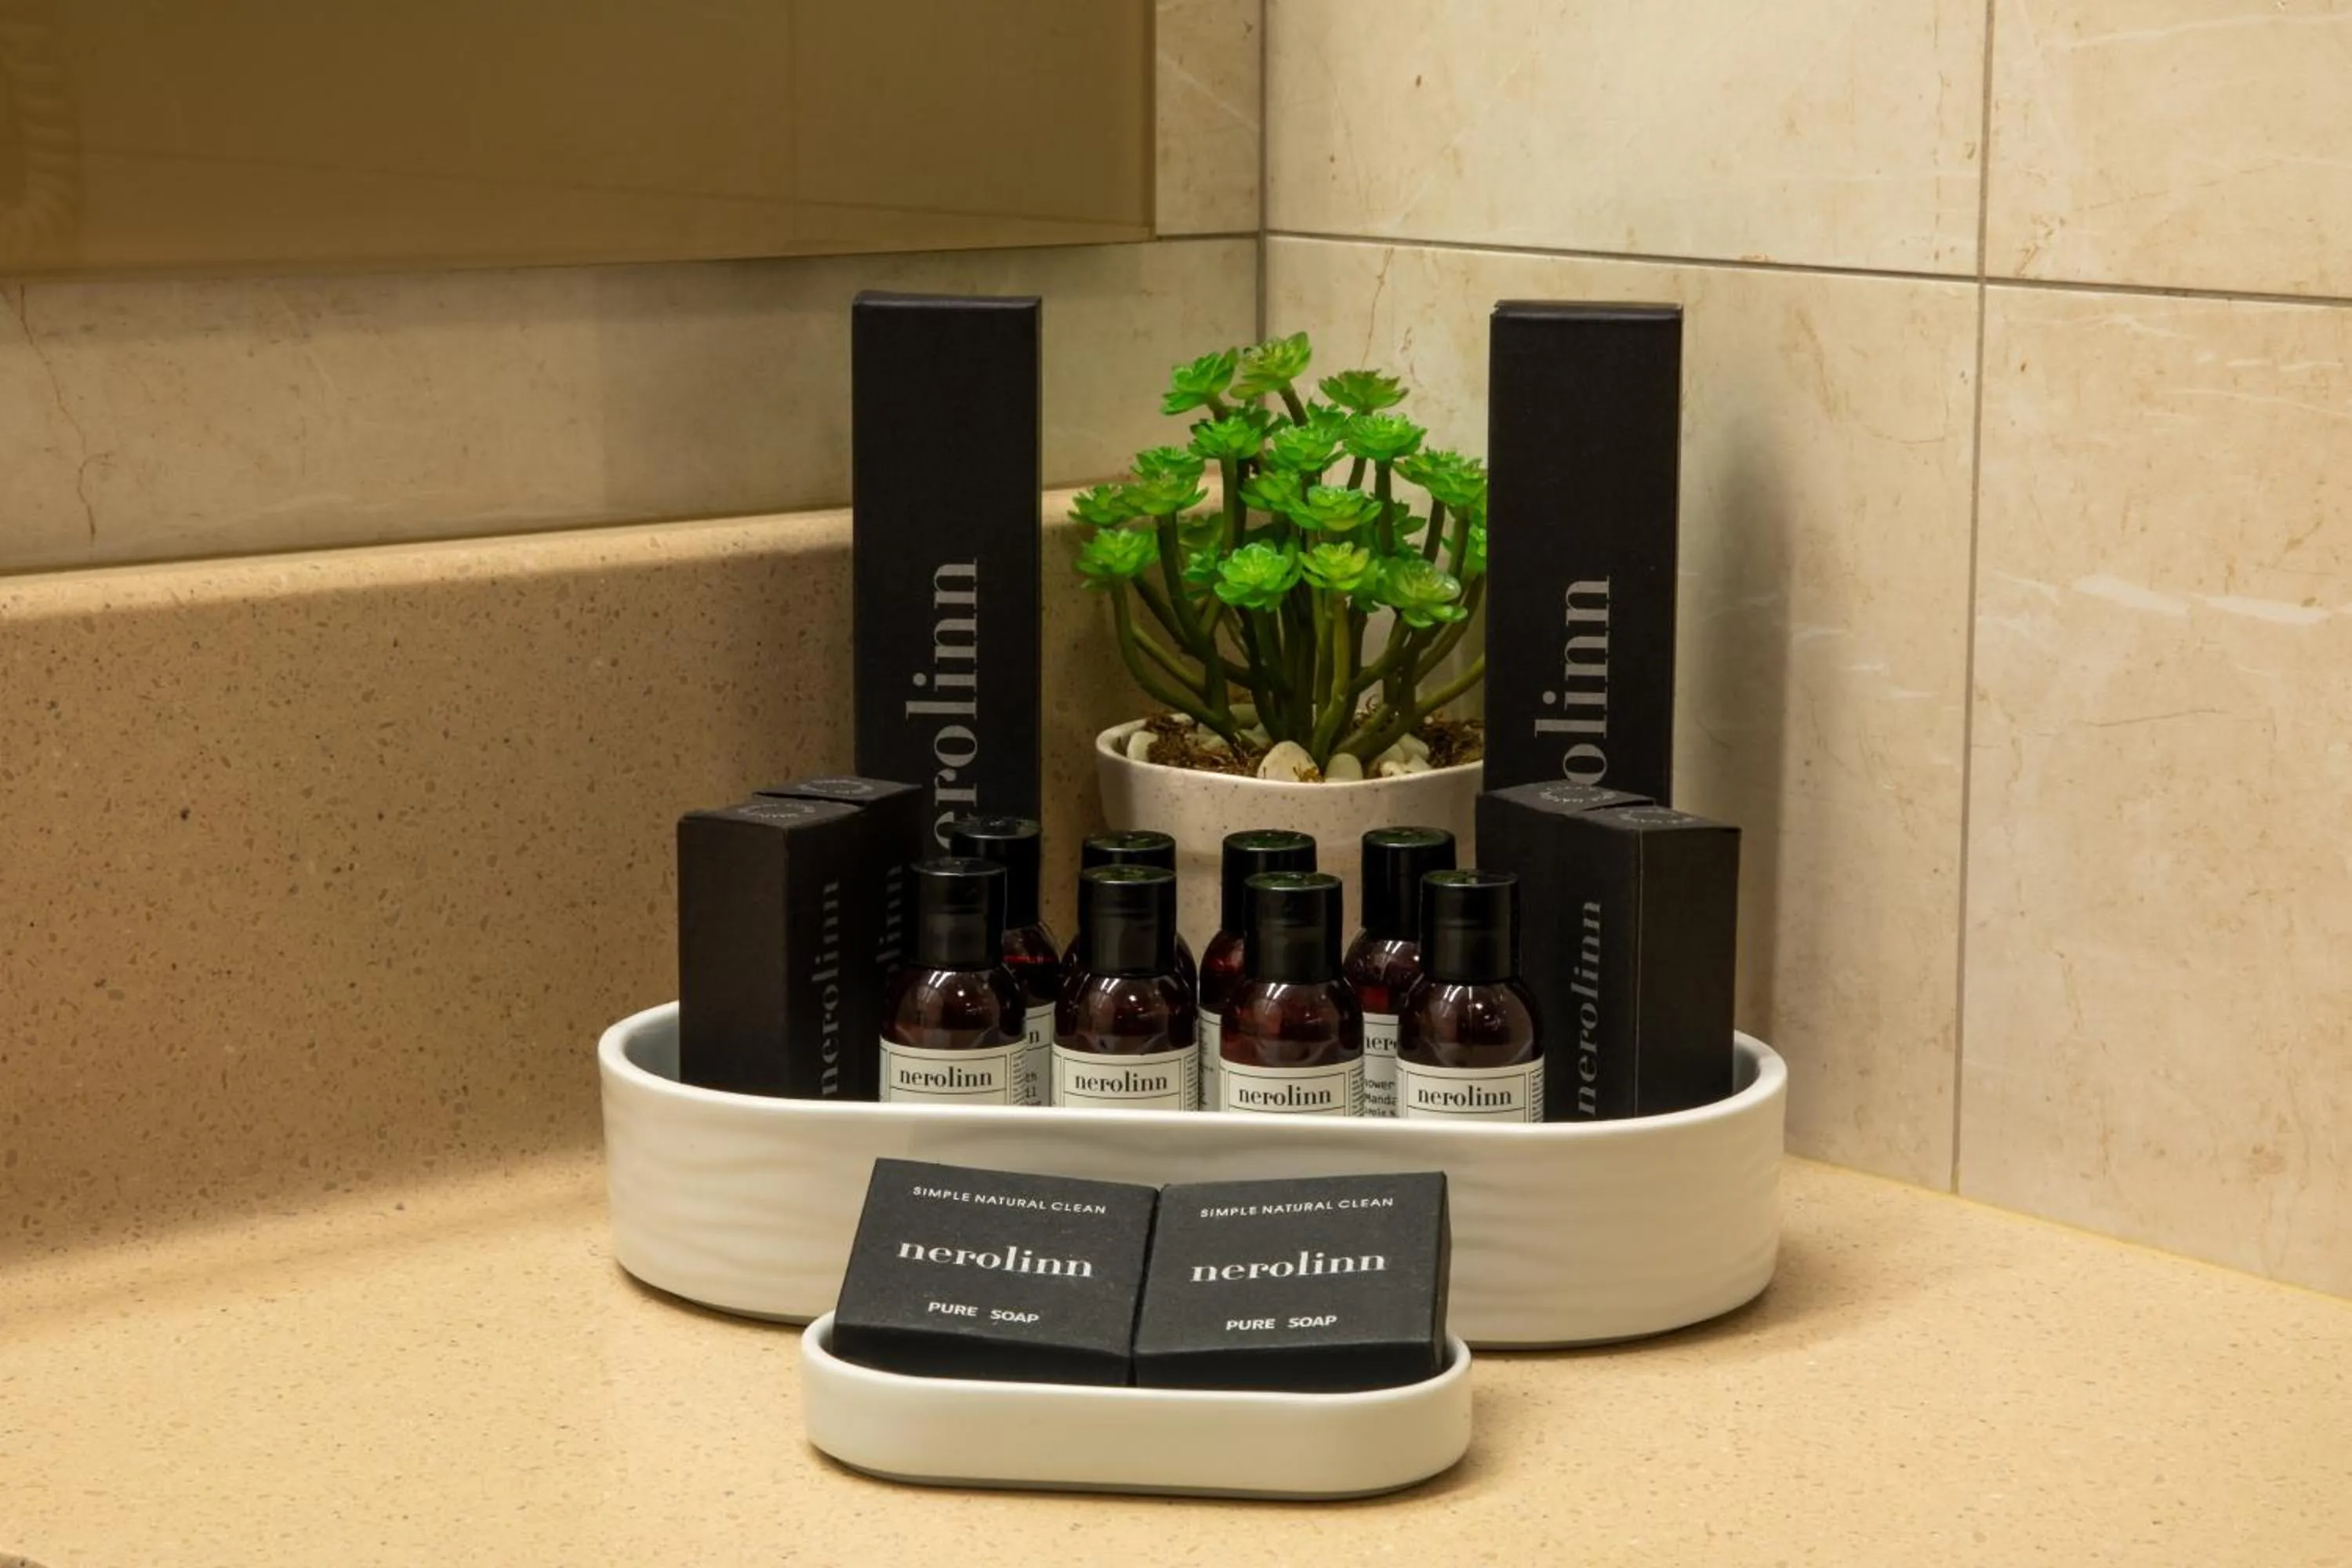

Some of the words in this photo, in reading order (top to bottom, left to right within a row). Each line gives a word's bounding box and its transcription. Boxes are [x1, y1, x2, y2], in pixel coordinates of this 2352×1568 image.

[811, 878, 839, 1096] nerolinn
[1570, 901, 1602, 1116] nerolinn
[899, 1066, 993, 1088] nerolinn
[1075, 1071, 1168, 1093] nerolinn
[1238, 1084, 1331, 1106] nerolinn
[1417, 1085, 1512, 1107] nerolinn
[913, 1186, 971, 1203] SIMPLE
[975, 1193, 1047, 1210] NATURAL
[1051, 1201, 1106, 1214] CLEAN
[1200, 1206, 1258, 1218] SIMPLE
[1261, 1200, 1334, 1215] NATURAL
[1338, 1197, 1393, 1210] CLEAN
[896, 1241, 1094, 1278] nerolinn
[1189, 1250, 1388, 1282] nerolinn
[927, 1301, 978, 1316] PURE
[990, 1309, 1040, 1323] SOAP
[1225, 1317, 1276, 1330] PURE
[1287, 1315, 1338, 1329] SOAP
